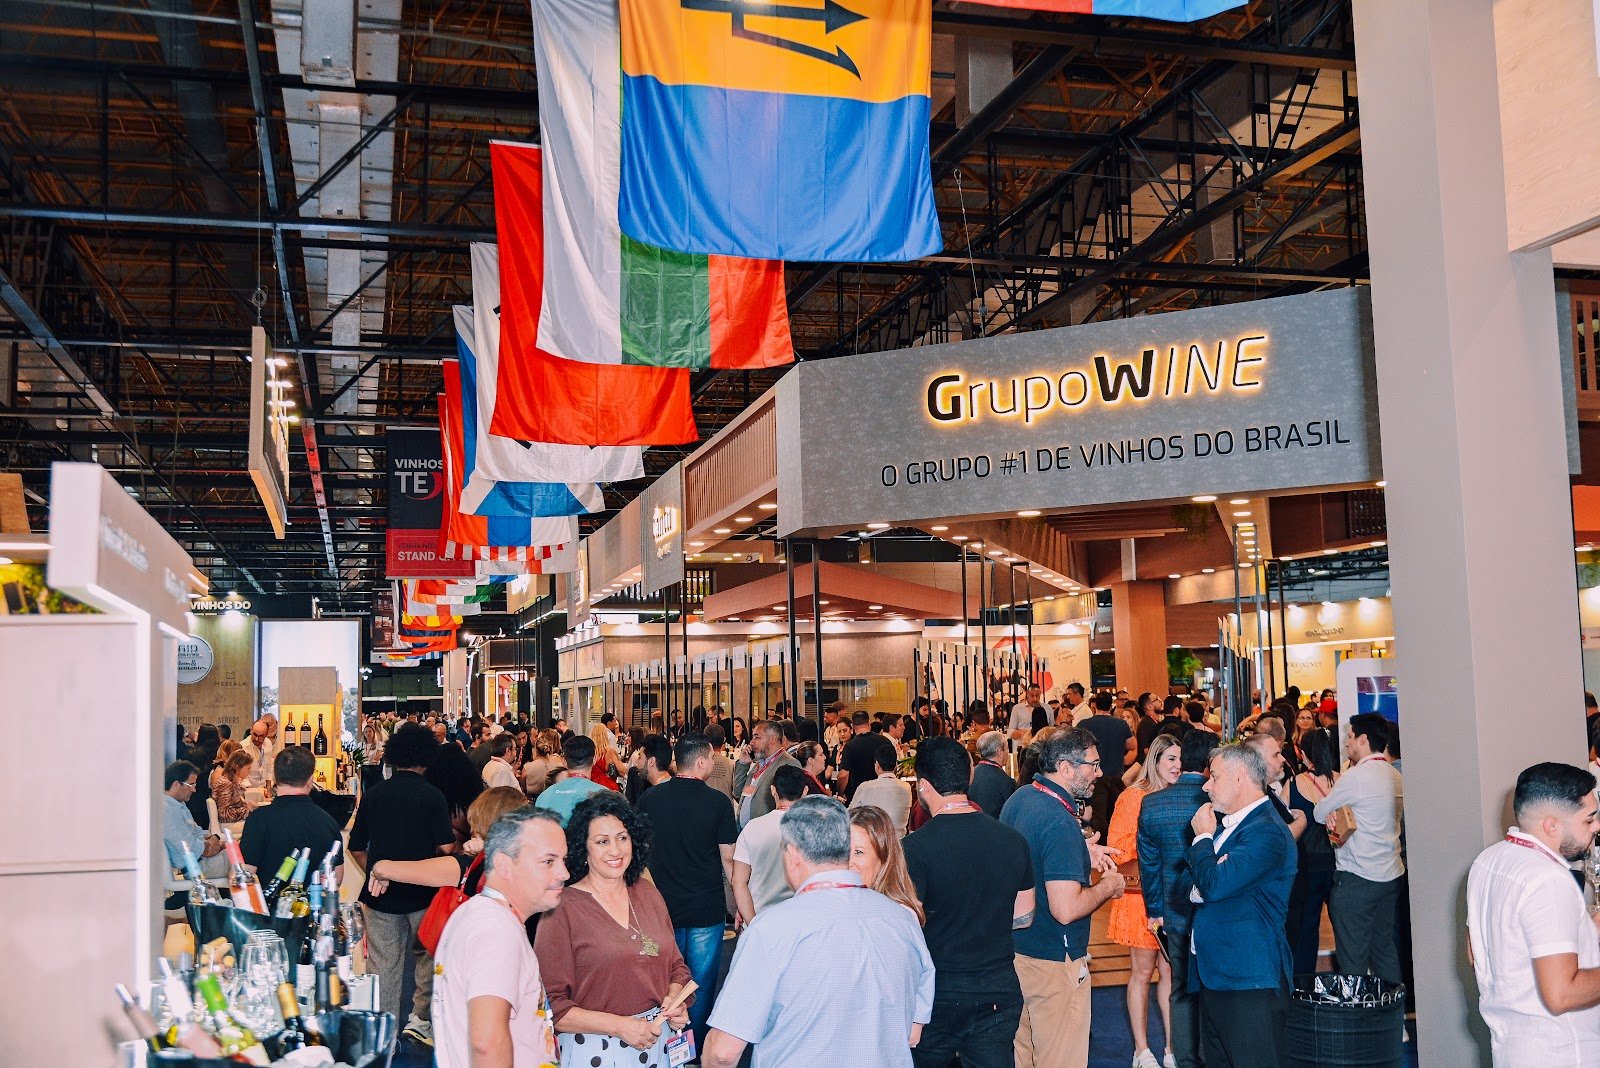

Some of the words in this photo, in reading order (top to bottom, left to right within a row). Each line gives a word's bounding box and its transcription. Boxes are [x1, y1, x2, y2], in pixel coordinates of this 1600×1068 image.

[926, 335, 1267, 423] GrupoWINE
[881, 465, 898, 487] O
[906, 454, 992, 486] GRUPO
[999, 450, 1028, 476] #1
[1036, 445, 1071, 472] DE
[1079, 434, 1185, 468] VINHOS
[1193, 429, 1233, 458] DO
[1244, 419, 1351, 453] BRASIL
[394, 459, 443, 469] VINHOS
[397, 551, 436, 561] STAND
[190, 600, 233, 610] VINHOS
[234, 600, 252, 610] DO
